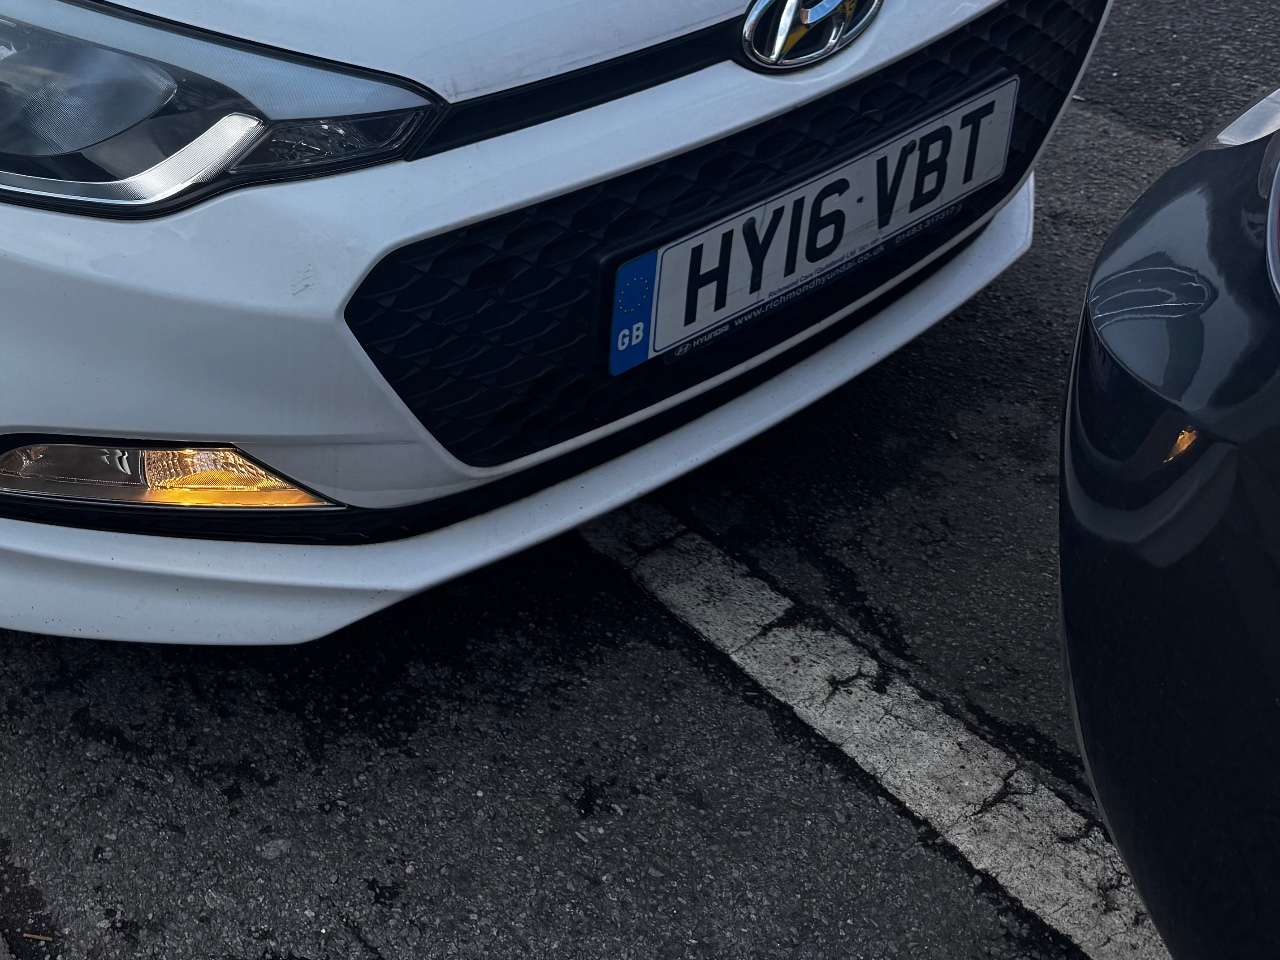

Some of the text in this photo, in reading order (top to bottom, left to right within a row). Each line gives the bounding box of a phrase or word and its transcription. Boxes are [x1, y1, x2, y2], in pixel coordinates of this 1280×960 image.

[683, 100, 996, 327] HY16 VBT
[617, 322, 645, 351] GB
